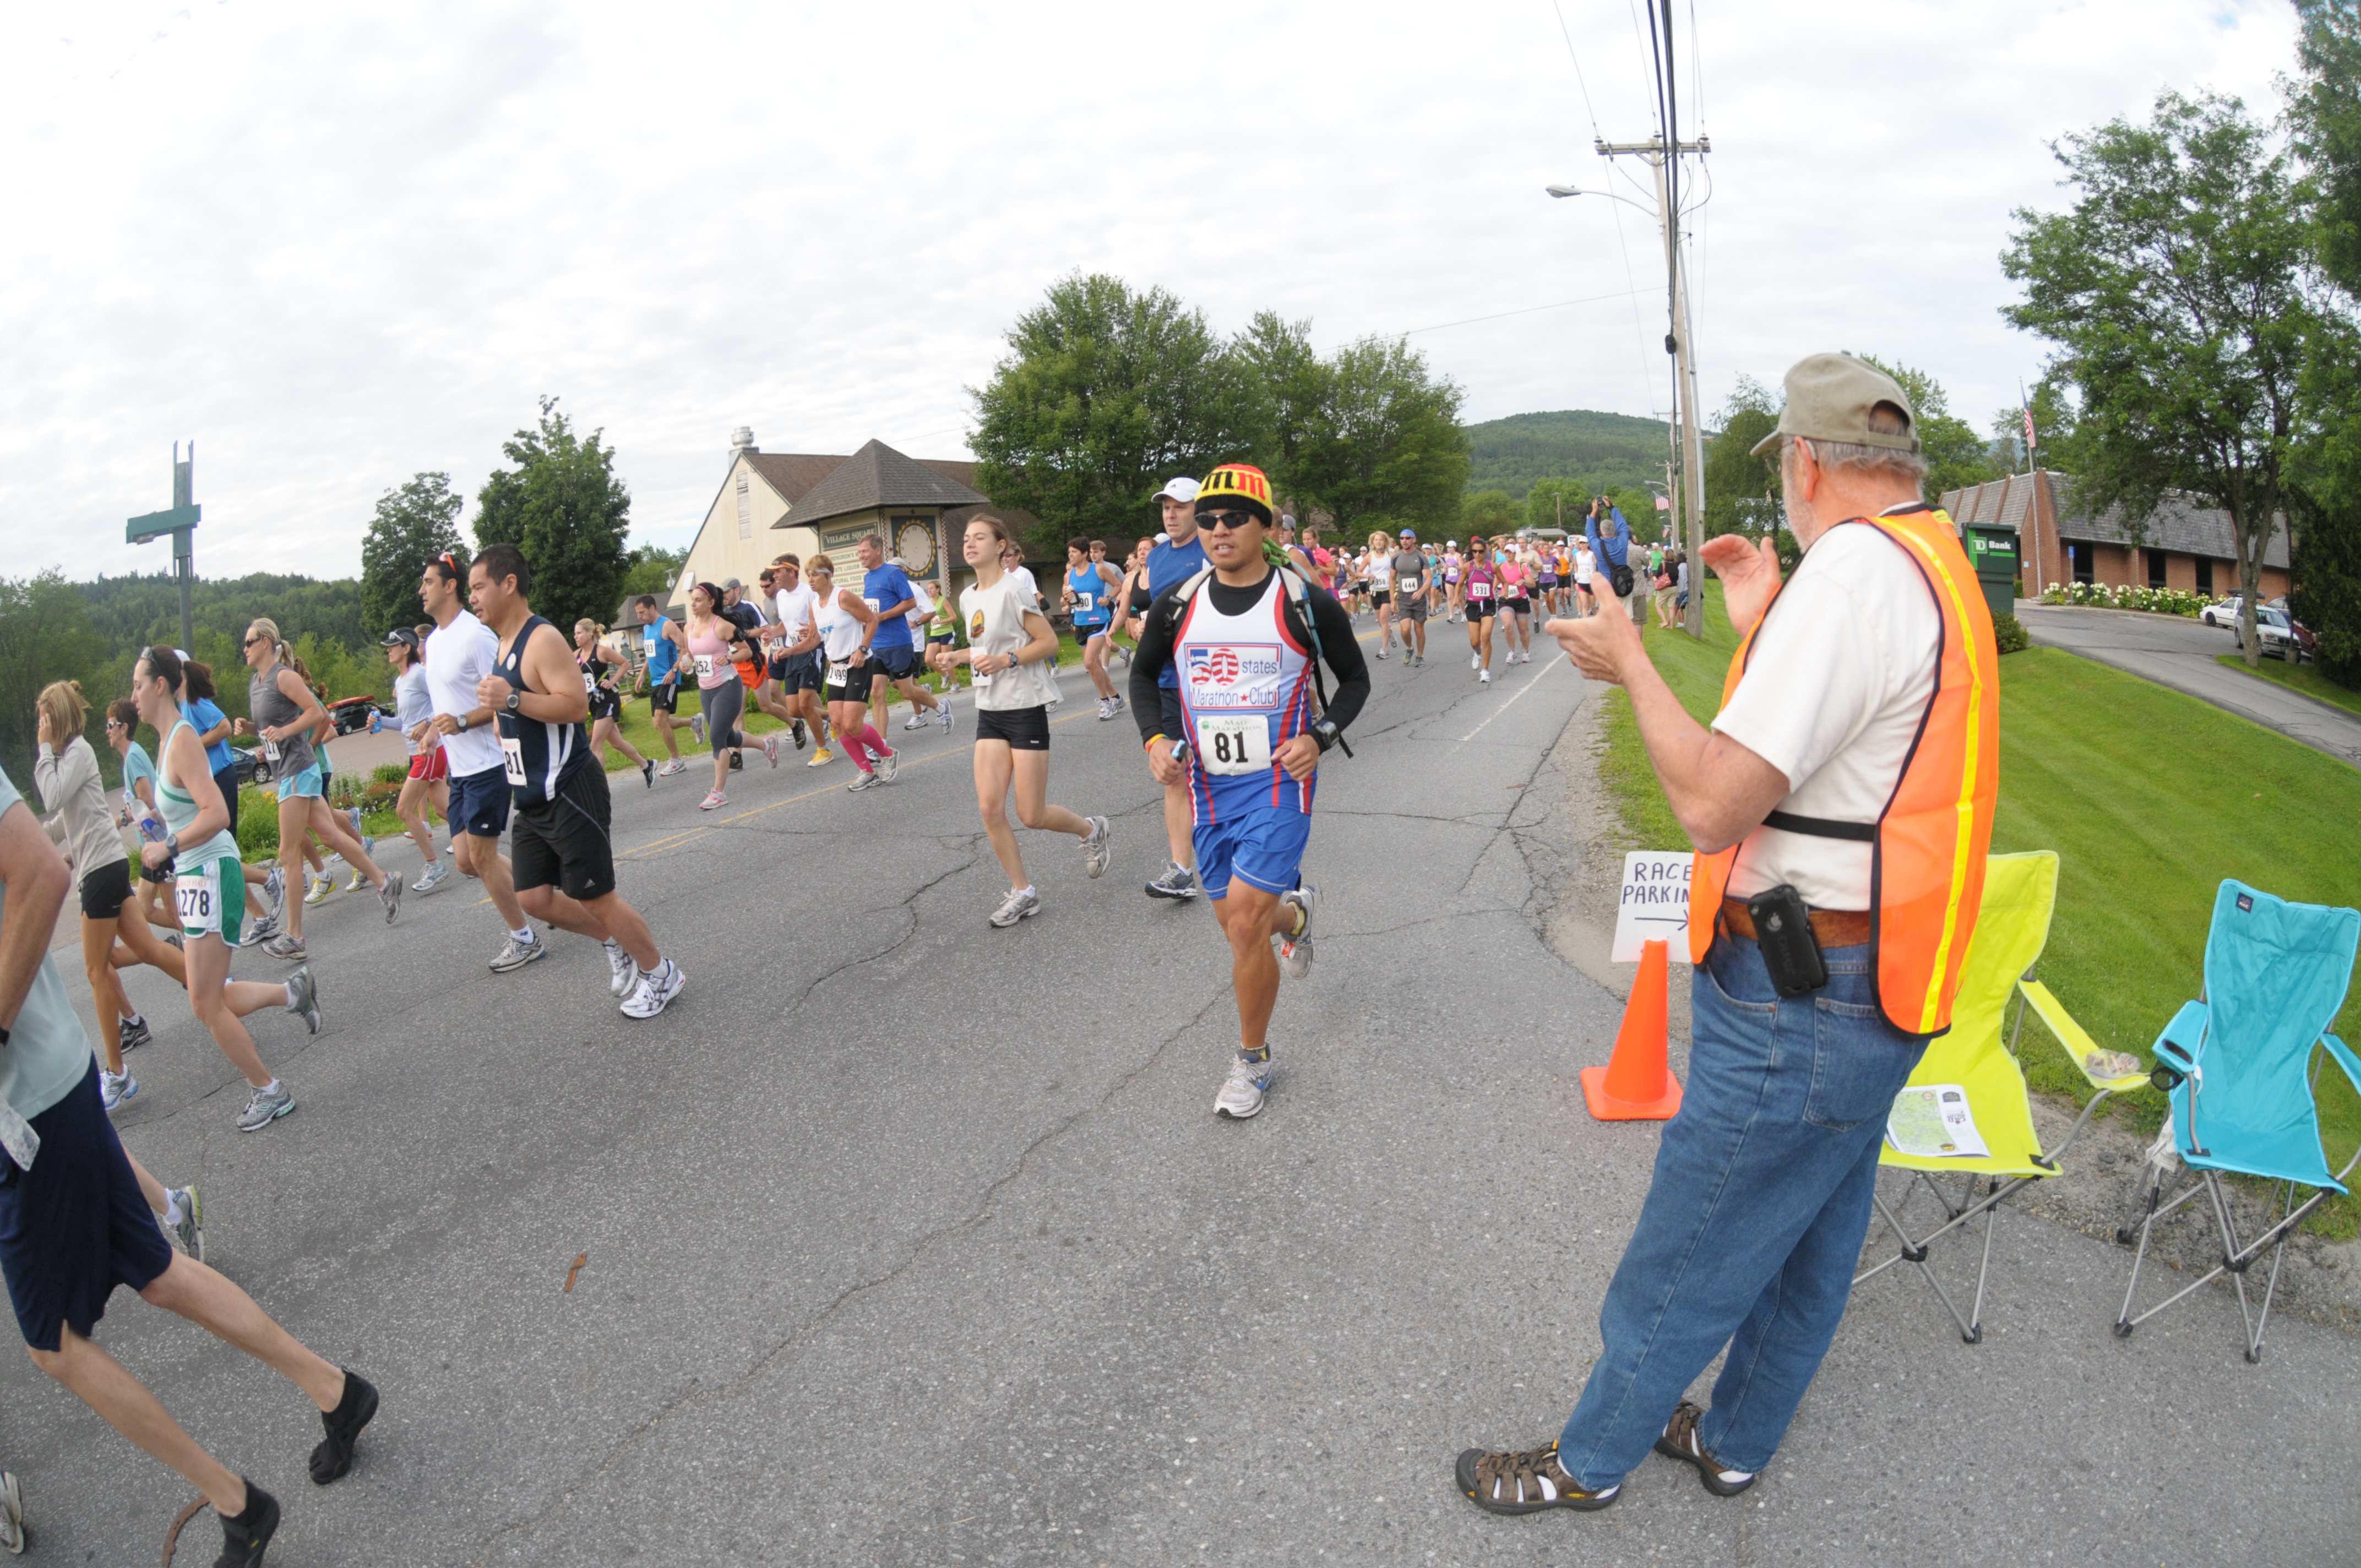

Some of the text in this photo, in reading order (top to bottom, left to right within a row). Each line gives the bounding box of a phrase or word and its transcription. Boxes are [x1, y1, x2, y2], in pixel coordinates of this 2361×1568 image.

[824, 528, 875, 544] VILLAGE SQUARE
[1973, 540, 2011, 551] TD Bank
[830, 552, 855, 561] EHURON'S
[1475, 586, 1487, 595] 531
[695, 661, 710, 673] 252
[1189, 647, 1277, 686] 50 states
[1192, 687, 1274, 706] Marathon Club
[1214, 731, 1249, 764] 81
[1634, 862, 1693, 882] RACE
[192, 878, 208, 888] HALF
[1622, 885, 1689, 905] PARKIN
